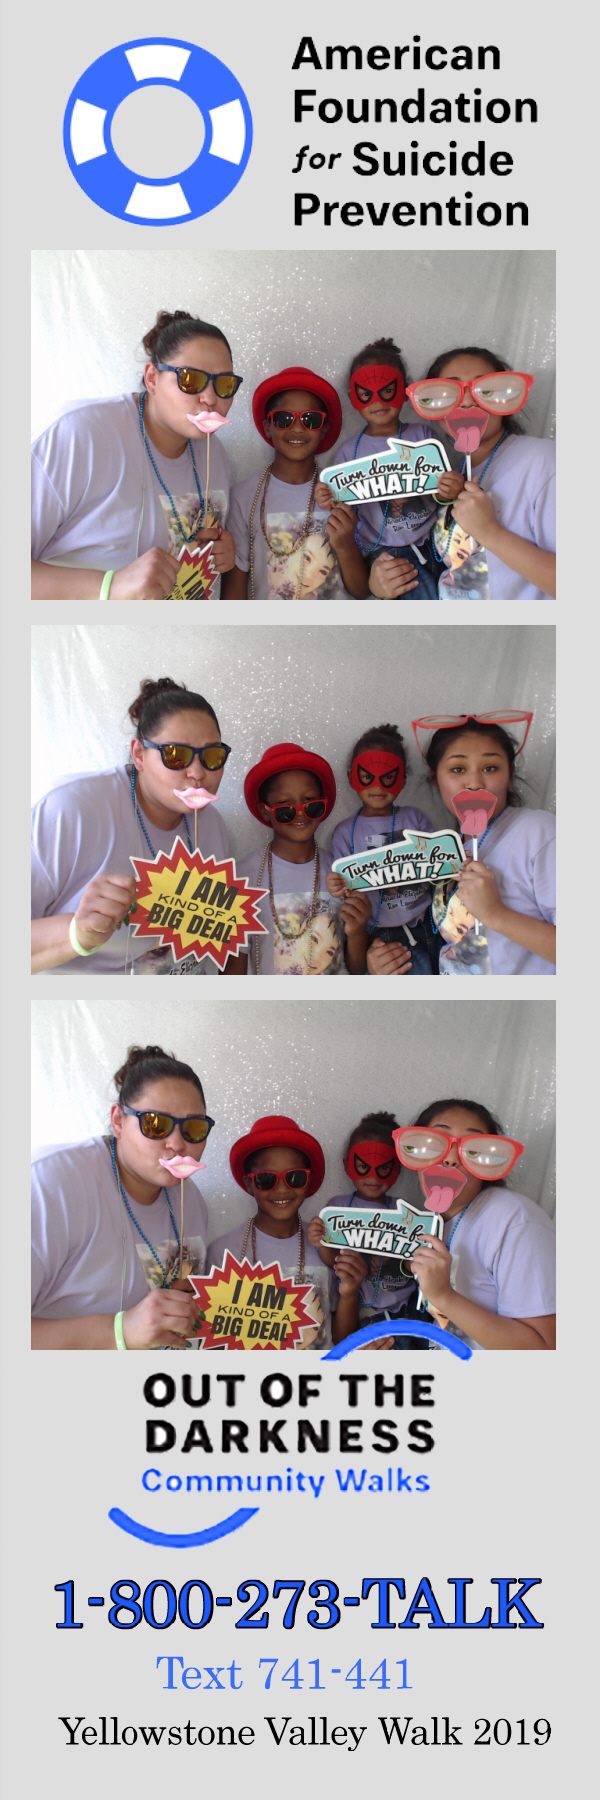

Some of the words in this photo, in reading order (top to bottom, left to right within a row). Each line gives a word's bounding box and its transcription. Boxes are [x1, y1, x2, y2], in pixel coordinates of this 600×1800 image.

[329, 468, 367, 490] Turn
[368, 458, 411, 478] down
[414, 455, 444, 477] for
[347, 472, 430, 500] WHAT!
[341, 860, 381, 879] Turn
[383, 849, 426, 865] down
[429, 845, 458, 864] for
[361, 861, 444, 887] WHAT!
[174, 870, 191, 896] I
[190, 876, 239, 911] AM
[146, 903, 185, 930] BIG
[186, 914, 233, 944] DEAL
[157, 893, 199, 912] KIND
[203, 907, 226, 918] OF
[227, 915, 238, 924] A
[327, 1214, 365, 1231] Turn
[368, 1213, 408, 1235] down
[342, 1228, 421, 1258] WHAT!
[232, 1280, 243, 1304] I
[247, 1282, 288, 1311] AM
[211, 1315, 243, 1337] BIG
[247, 1320, 289, 1342] DEAL
[217, 1305, 255, 1318] KIND
[259, 1310, 280, 1320] OF
[281, 1313, 291, 1322] A
